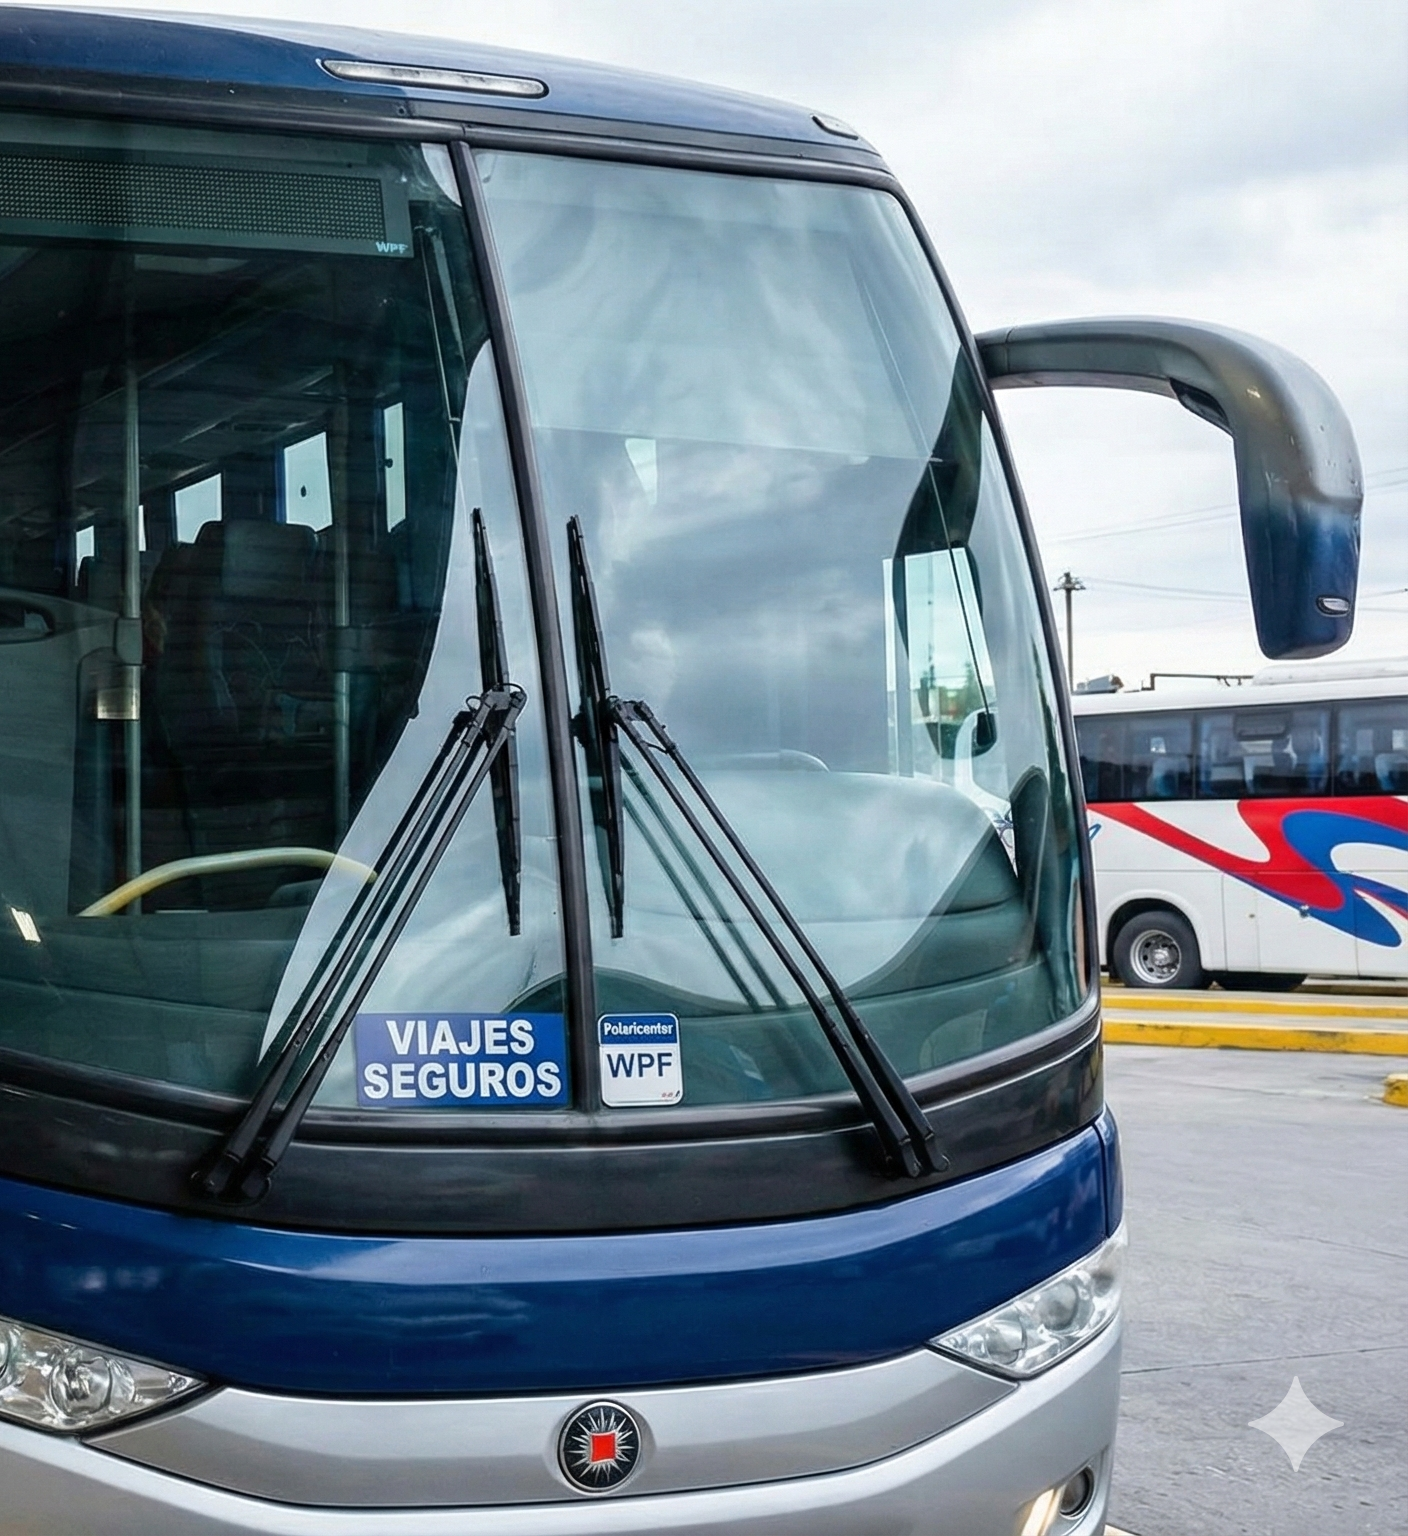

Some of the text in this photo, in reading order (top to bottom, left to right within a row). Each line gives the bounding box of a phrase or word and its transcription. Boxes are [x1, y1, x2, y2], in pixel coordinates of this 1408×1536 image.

[375, 241, 408, 254] WPF
[386, 1019, 535, 1055] VIAJES
[363, 1061, 562, 1099] SEGUROS
[606, 1052, 672, 1078] WPF
